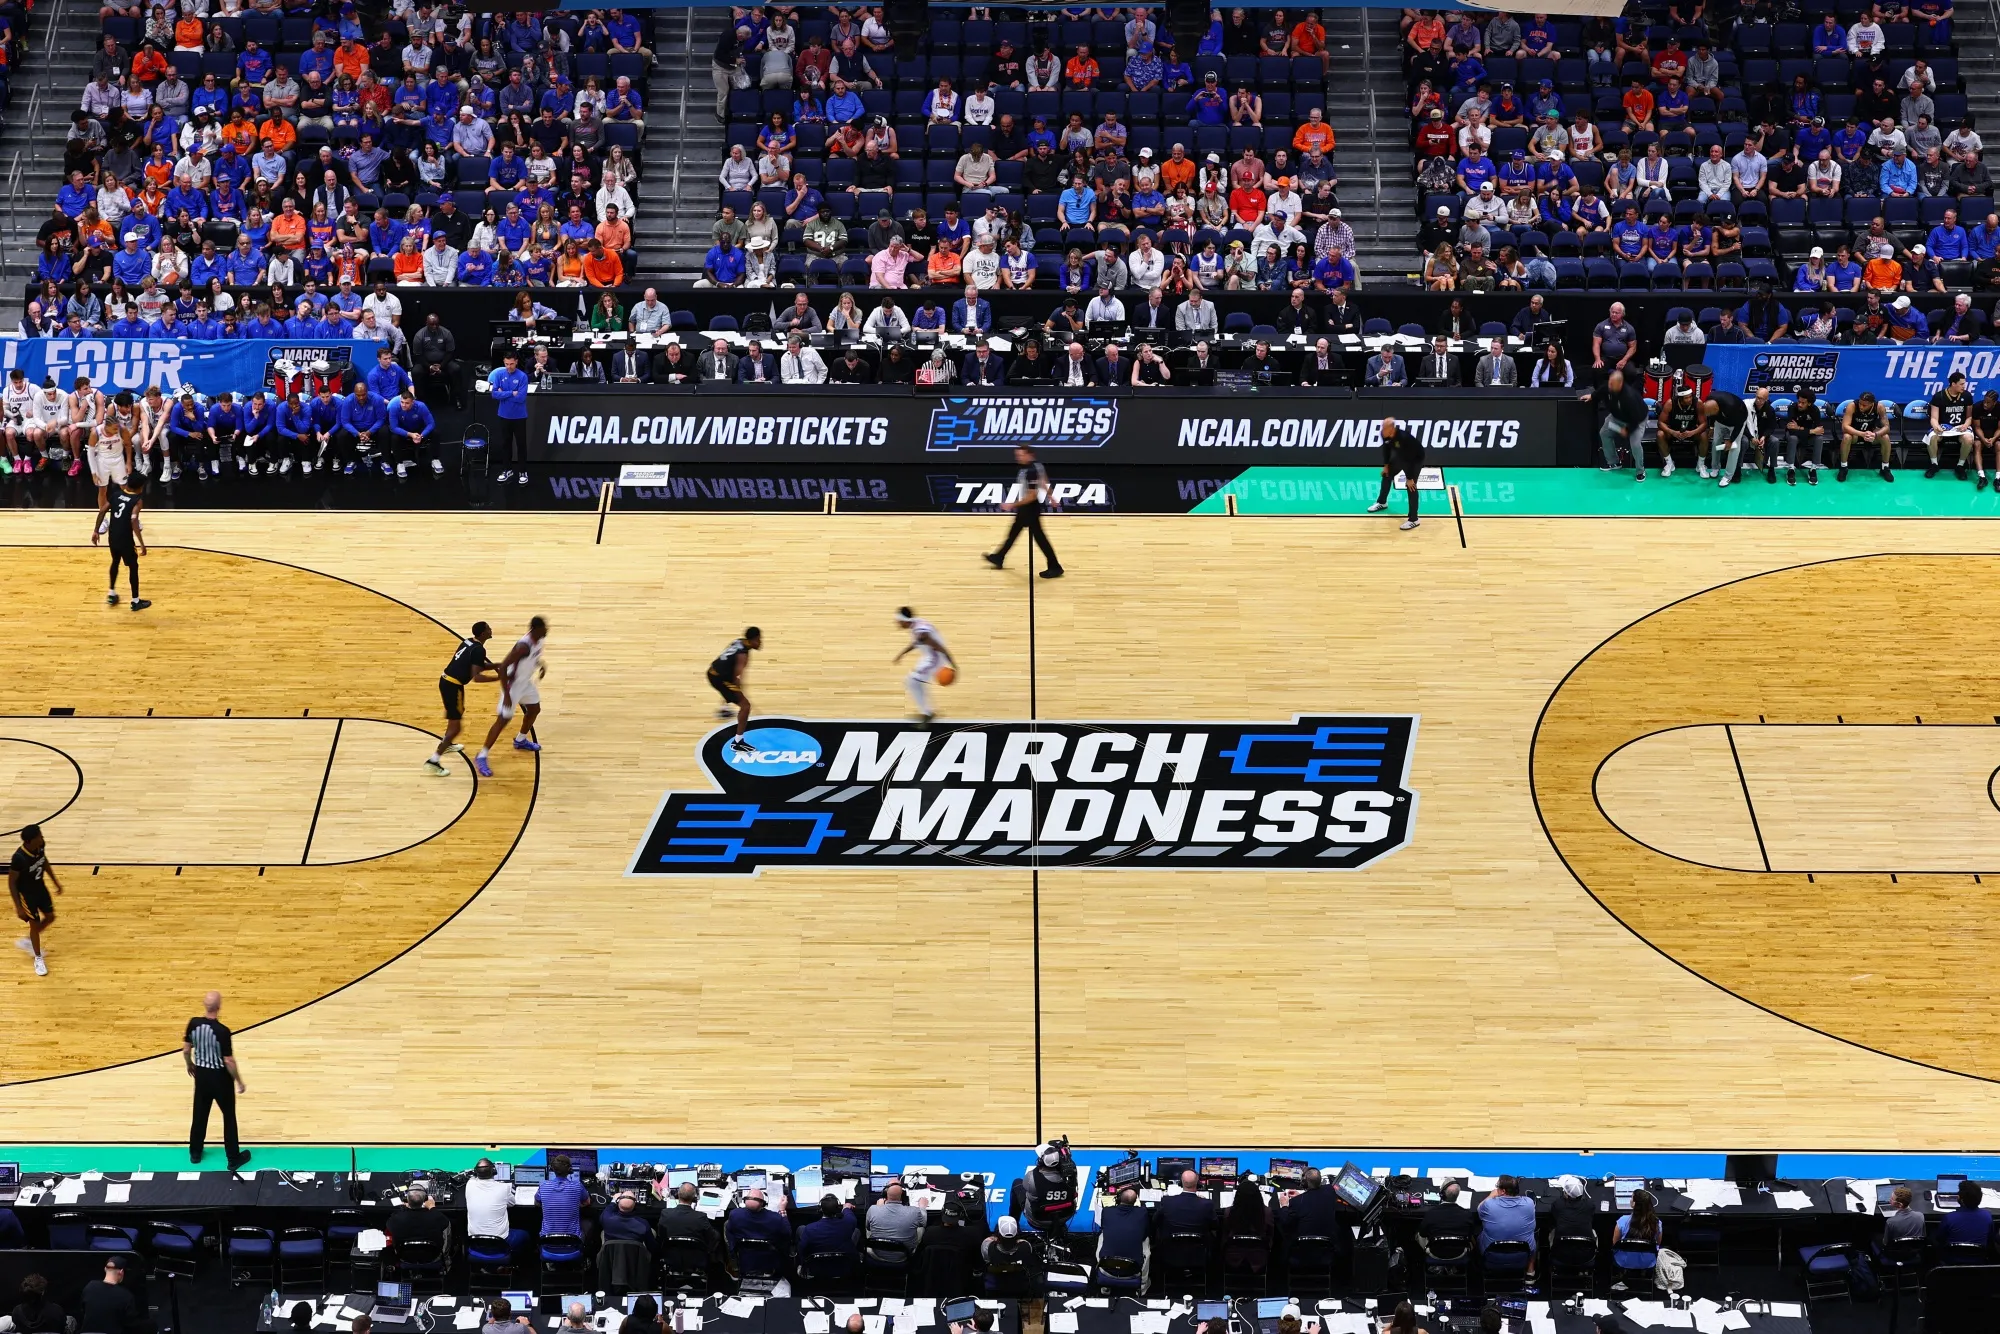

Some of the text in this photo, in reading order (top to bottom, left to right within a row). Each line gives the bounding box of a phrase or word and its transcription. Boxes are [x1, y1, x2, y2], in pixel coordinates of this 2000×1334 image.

[814, 231, 836, 247] 94
[284, 349, 328, 361] MARCH
[1768, 355, 1815, 368] MARCH
[45, 340, 182, 389] FOUR
[1885, 350, 1944, 379] THE
[1772, 367, 1834, 380] MADNESS
[1923, 381, 1944, 396] TO
[983, 407, 1113, 435] MADNESS
[1949, 413, 1962, 424] 25
[547, 415, 889, 446] NCAA.COM/MBBTICKETS
[114, 502, 126, 518] 3
[454, 646, 467, 661] 4
[731, 749, 817, 765] NCAA
[826, 731, 1209, 783] MARCH
[868, 788, 1394, 843] MADNESS
[35, 866, 42, 880] 2
[1046, 1190, 1068, 1201] 593
